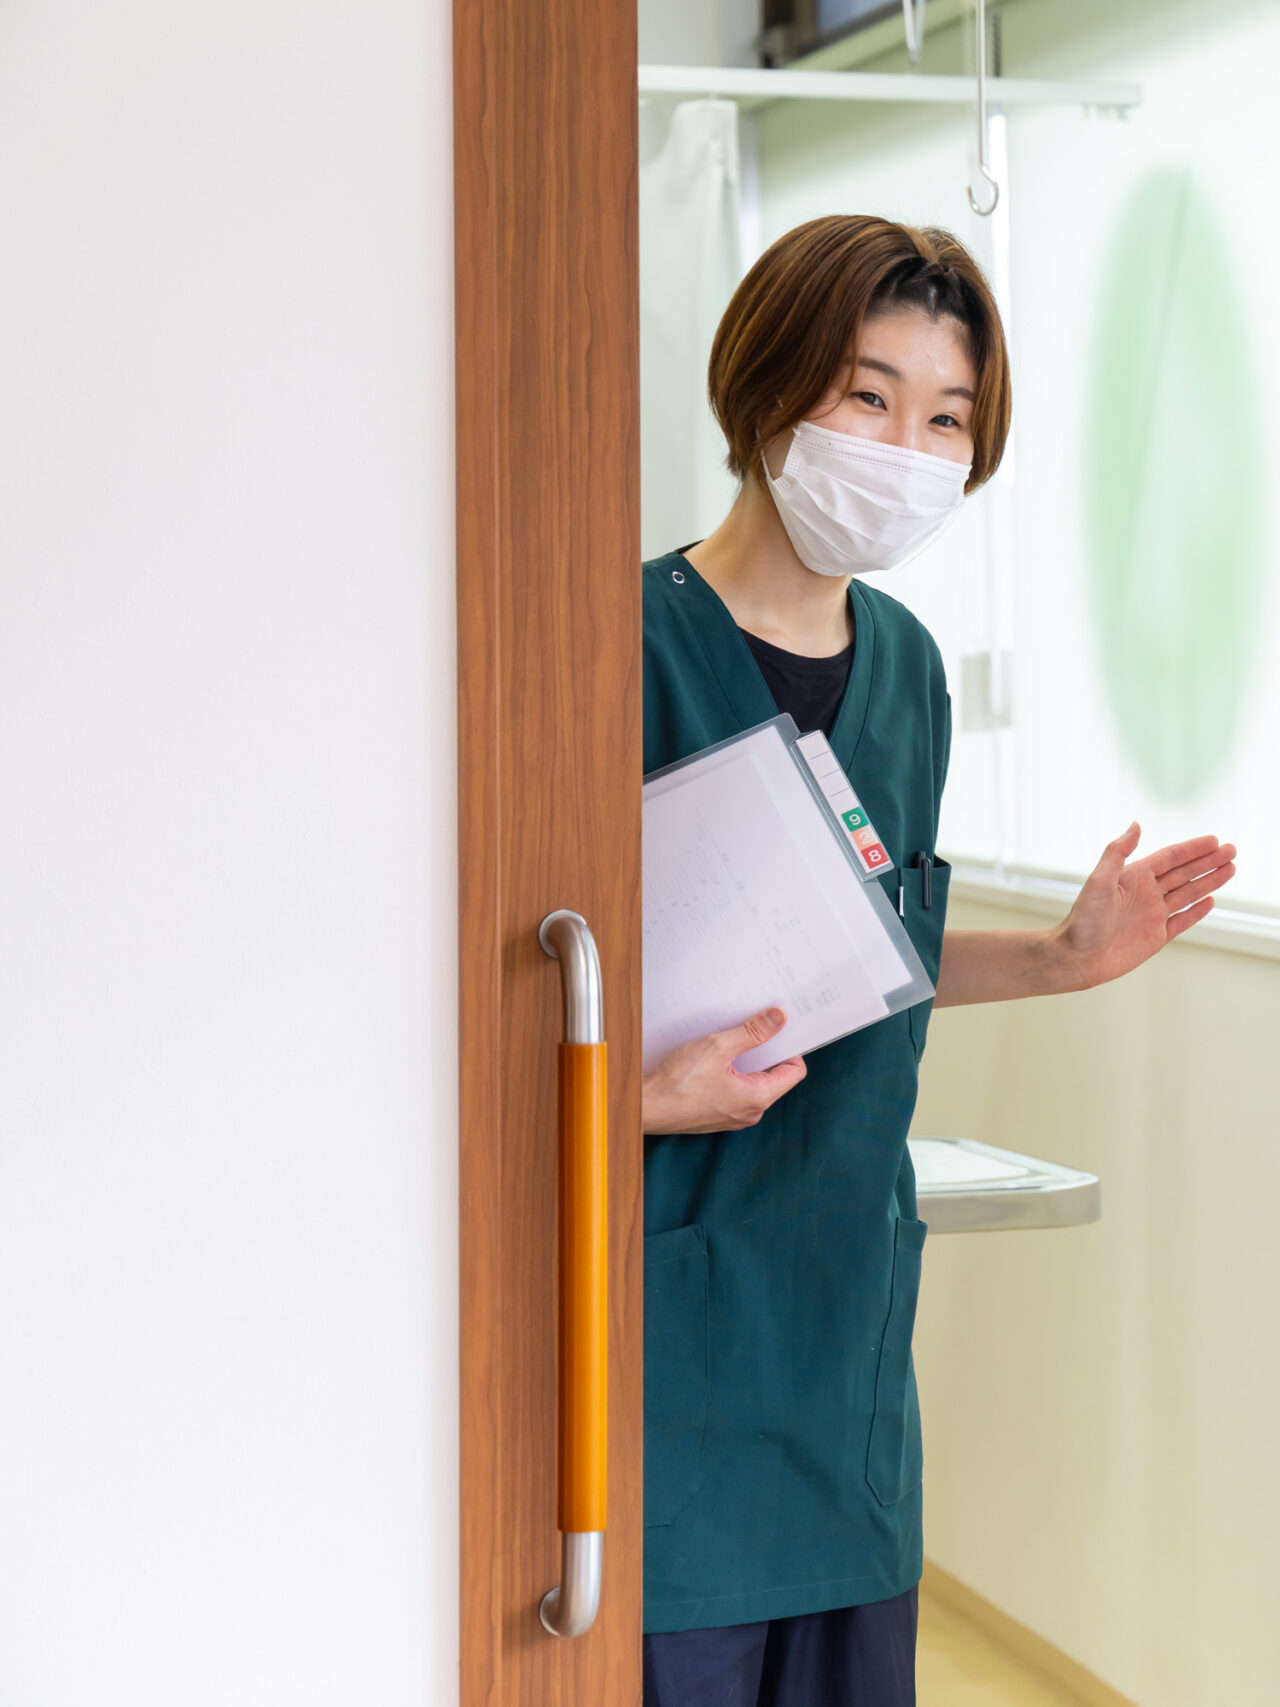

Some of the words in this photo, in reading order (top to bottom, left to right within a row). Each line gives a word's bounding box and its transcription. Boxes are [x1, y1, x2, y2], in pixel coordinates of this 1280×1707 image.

[849, 813, 862, 826] 9
[859, 832, 872, 845] 2
[868, 849, 882, 863] 8
